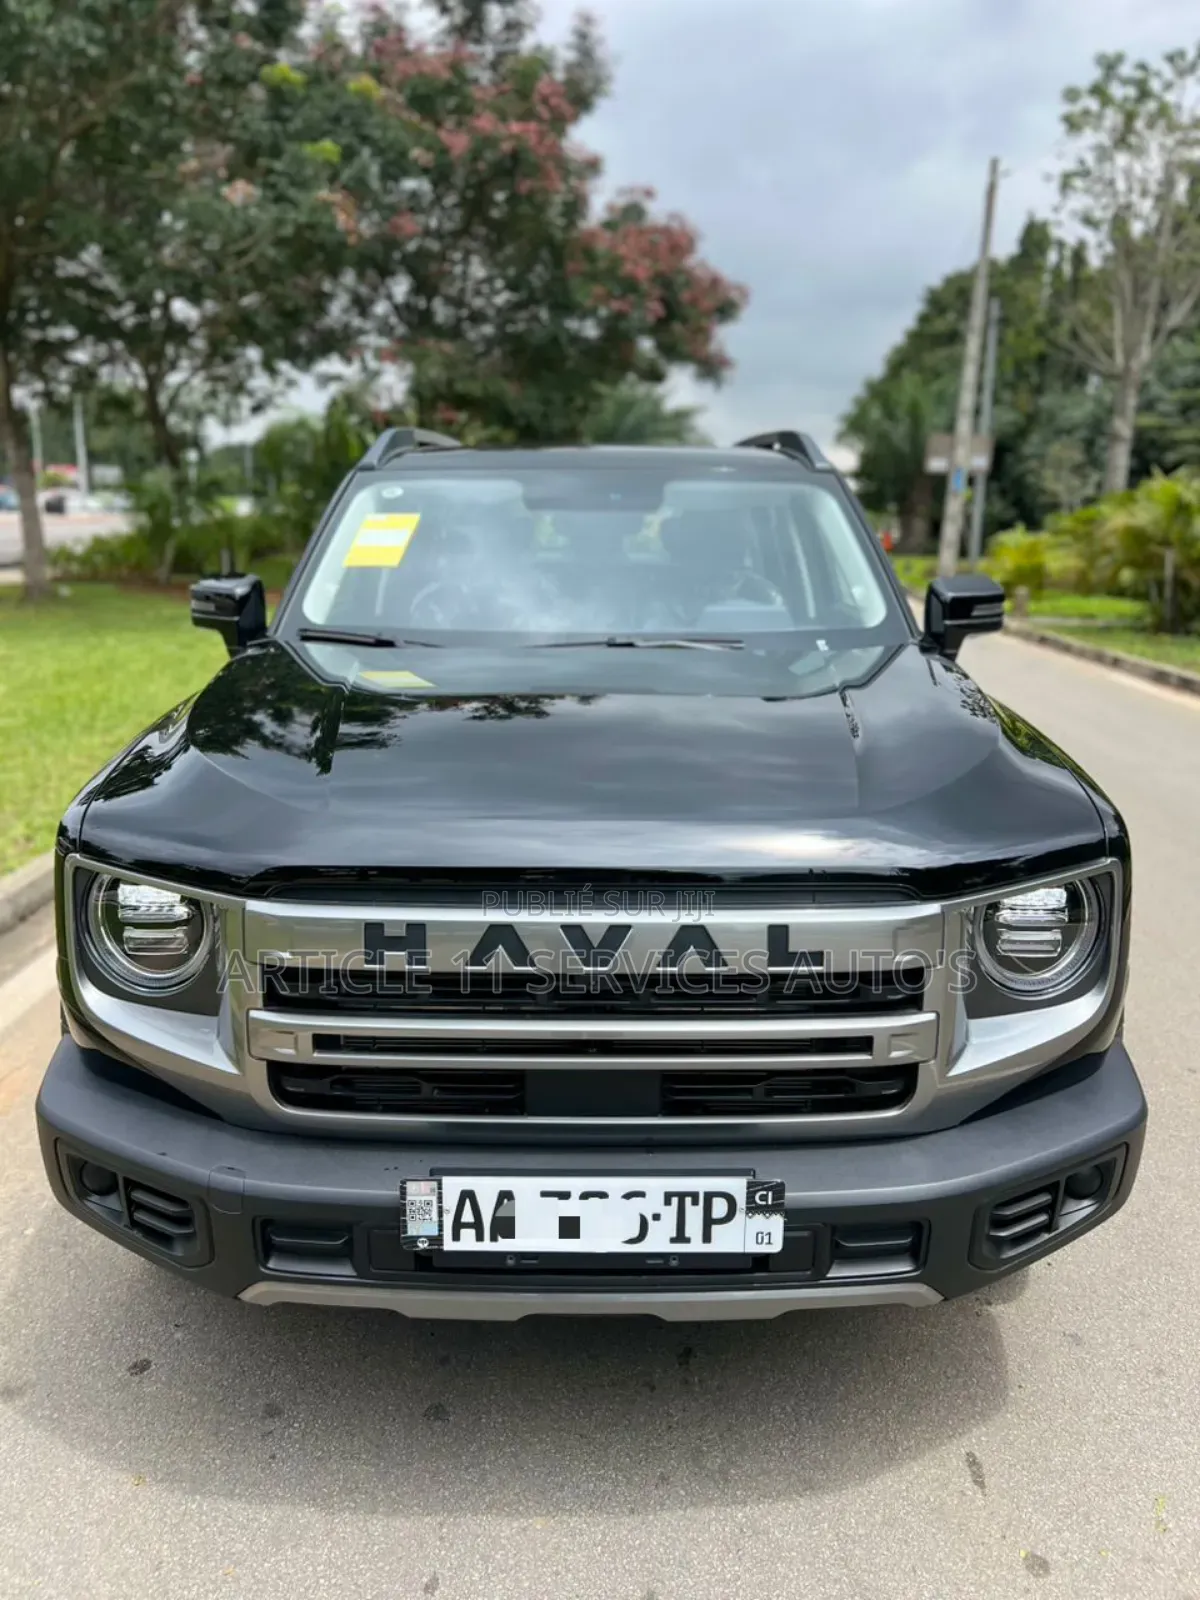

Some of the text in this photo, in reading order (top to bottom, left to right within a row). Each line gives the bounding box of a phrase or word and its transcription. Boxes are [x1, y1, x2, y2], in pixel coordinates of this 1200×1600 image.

[364, 922, 824, 969] HAVAL
[754, 1190, 773, 1205] CI
[755, 1231, 773, 1245] 01
